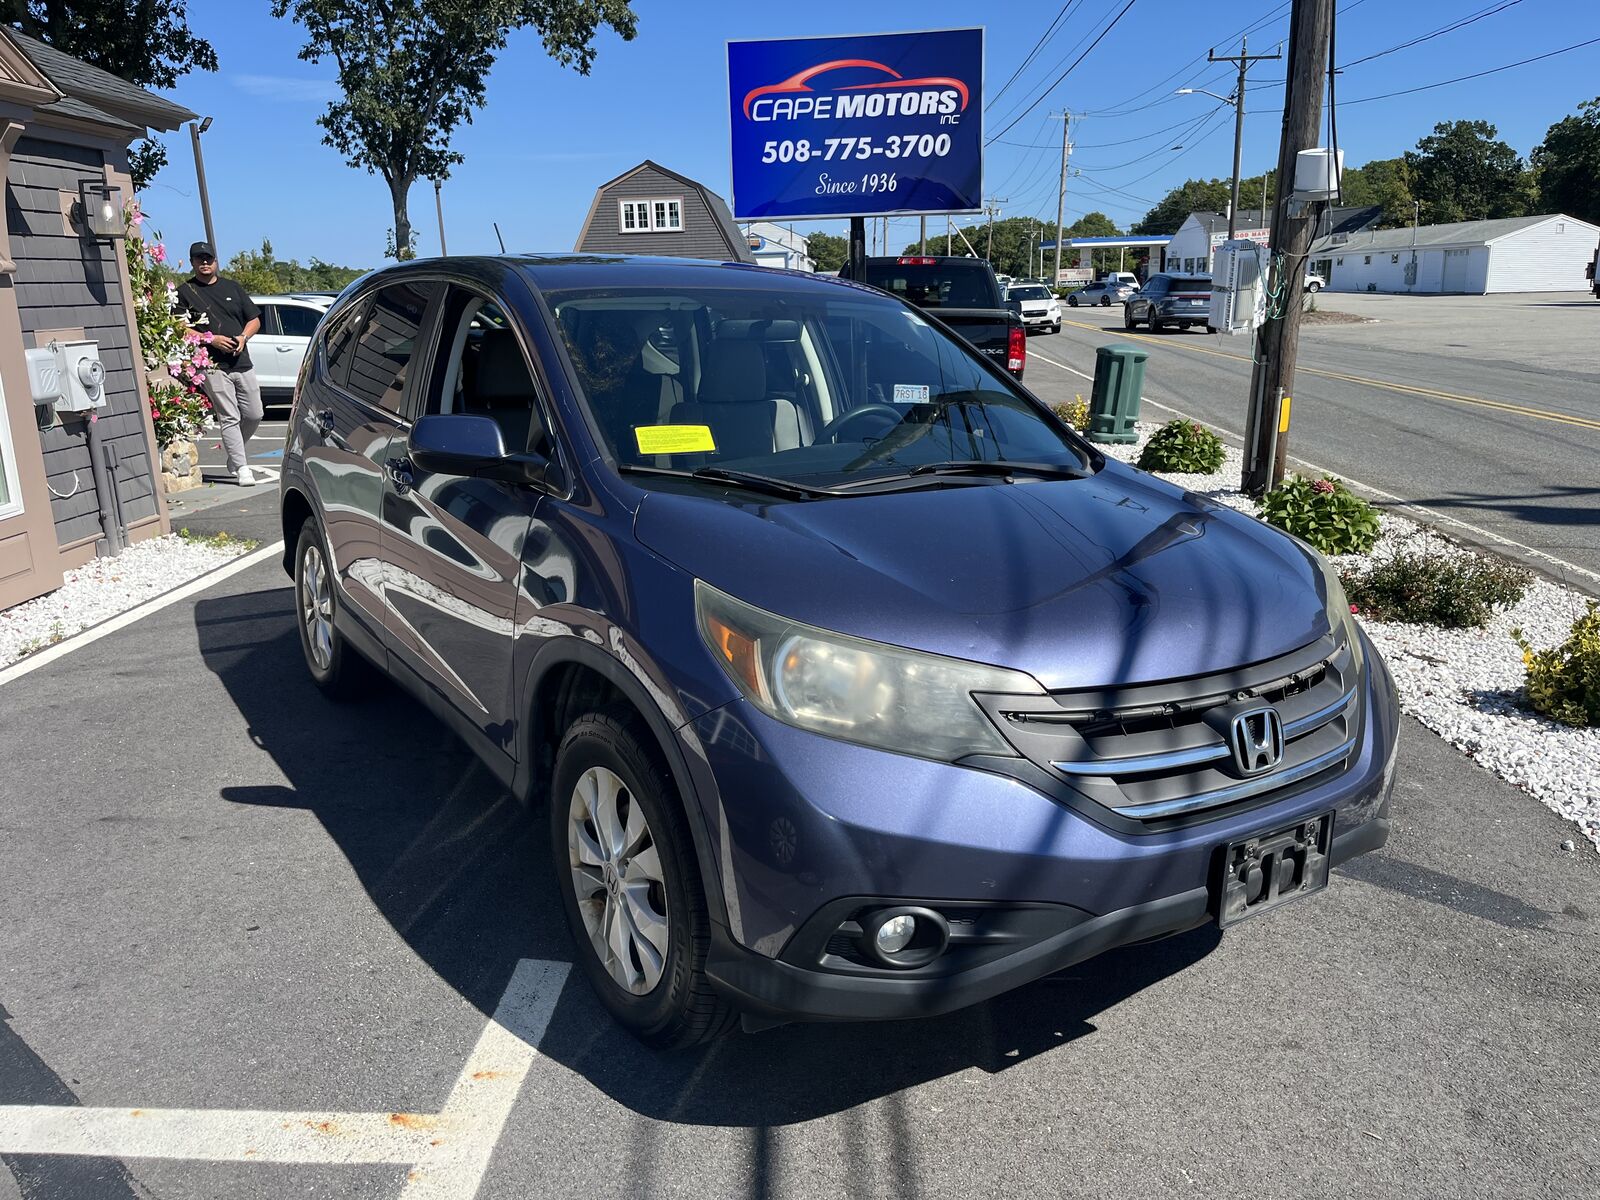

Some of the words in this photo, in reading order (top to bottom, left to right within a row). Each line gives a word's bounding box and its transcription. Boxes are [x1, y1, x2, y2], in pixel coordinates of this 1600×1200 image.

[752, 96, 832, 122] CAPE
[835, 90, 958, 119] MOTORS
[761, 133, 951, 164] 508-775-3700
[815, 172, 858, 194] Since
[861, 172, 897, 193] 1936
